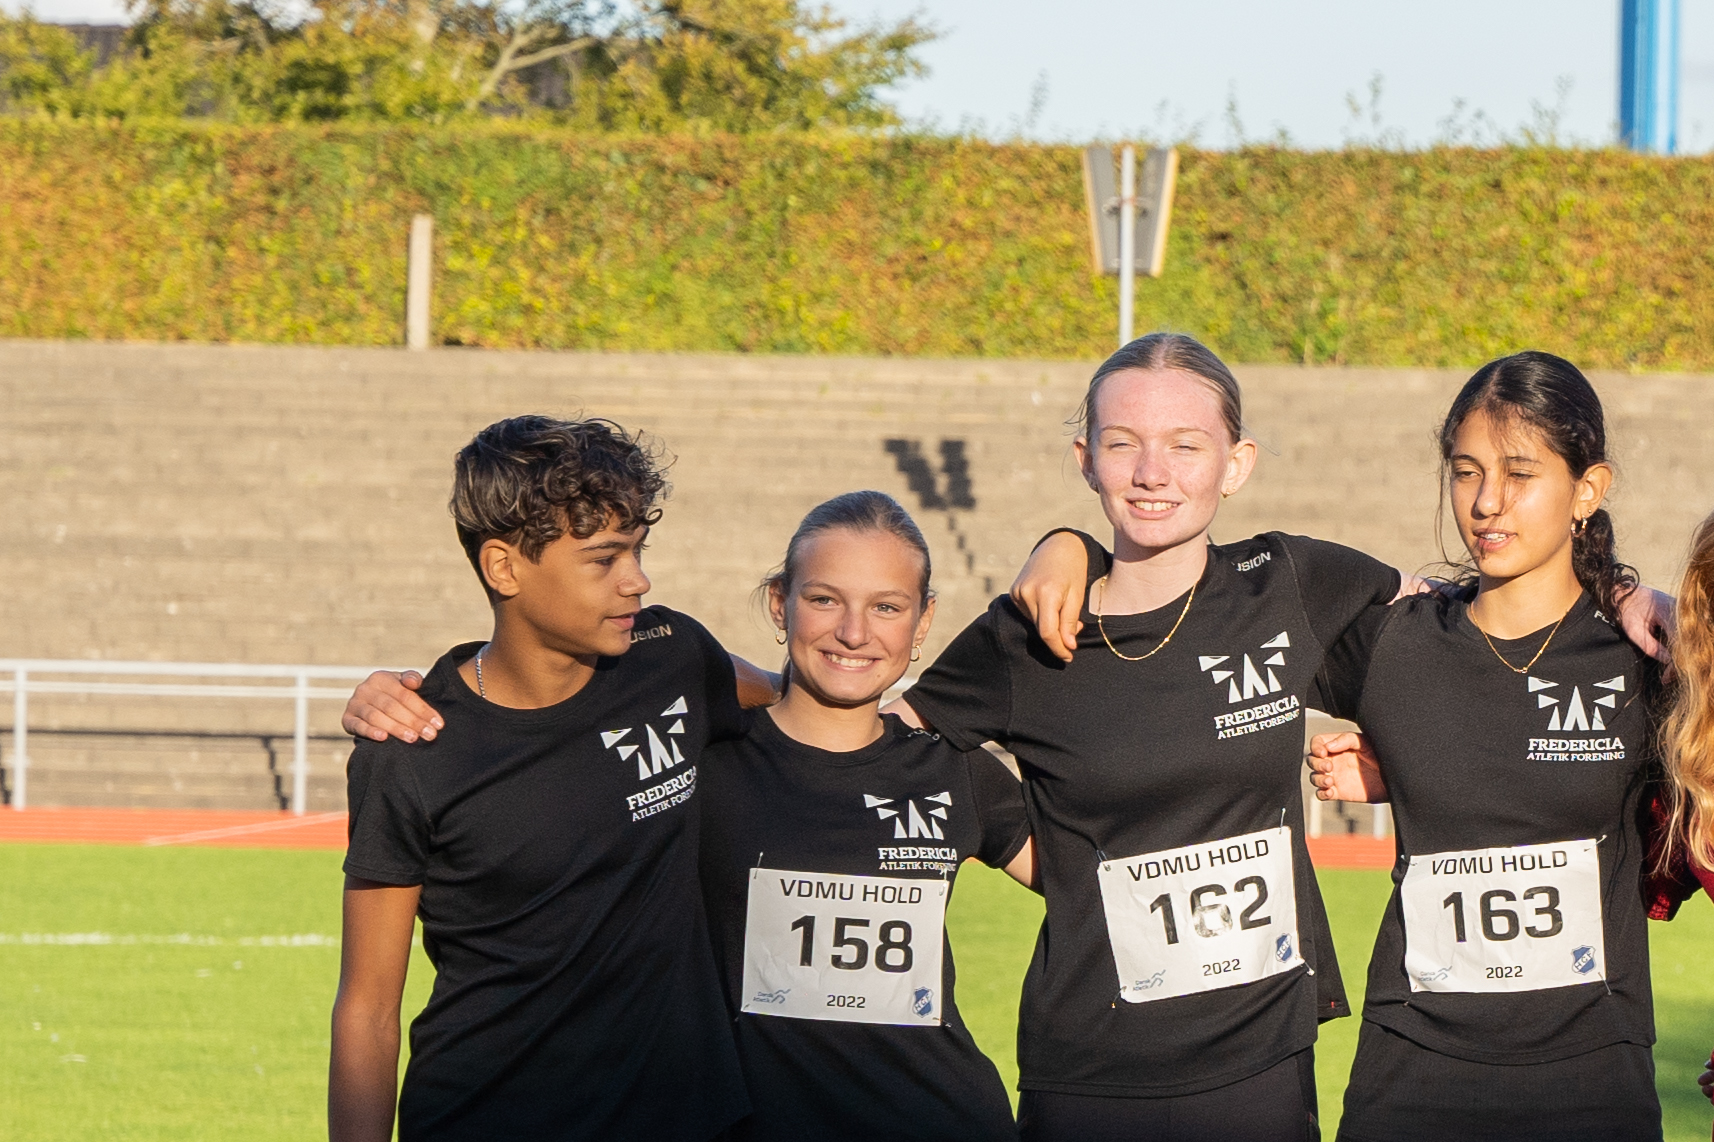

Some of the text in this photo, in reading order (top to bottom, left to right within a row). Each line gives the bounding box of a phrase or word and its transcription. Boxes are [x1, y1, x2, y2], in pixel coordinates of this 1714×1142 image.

[630, 624, 672, 643] USION
[1214, 695, 1300, 729] FREDERICIA
[1217, 722, 1260, 740] ATLETIK
[1528, 737, 1625, 752] FREDERICIA
[1526, 751, 1625, 761] ATLETIK FORENING
[632, 799, 671, 822] ATLETIK
[878, 847, 957, 861] FREDERICIA
[1127, 839, 1270, 882] VDMU HOLD
[1431, 850, 1568, 875] VDMU HOLD
[880, 861, 921, 870] ATLETIK
[780, 879, 922, 904] VDMU HOLD
[1149, 875, 1272, 945] 162
[1443, 885, 1564, 943] 163
[790, 914, 914, 973] 158
[1202, 958, 1242, 976] 2022
[1486, 966, 1523, 979] 2022
[826, 995, 866, 1009] 2022
